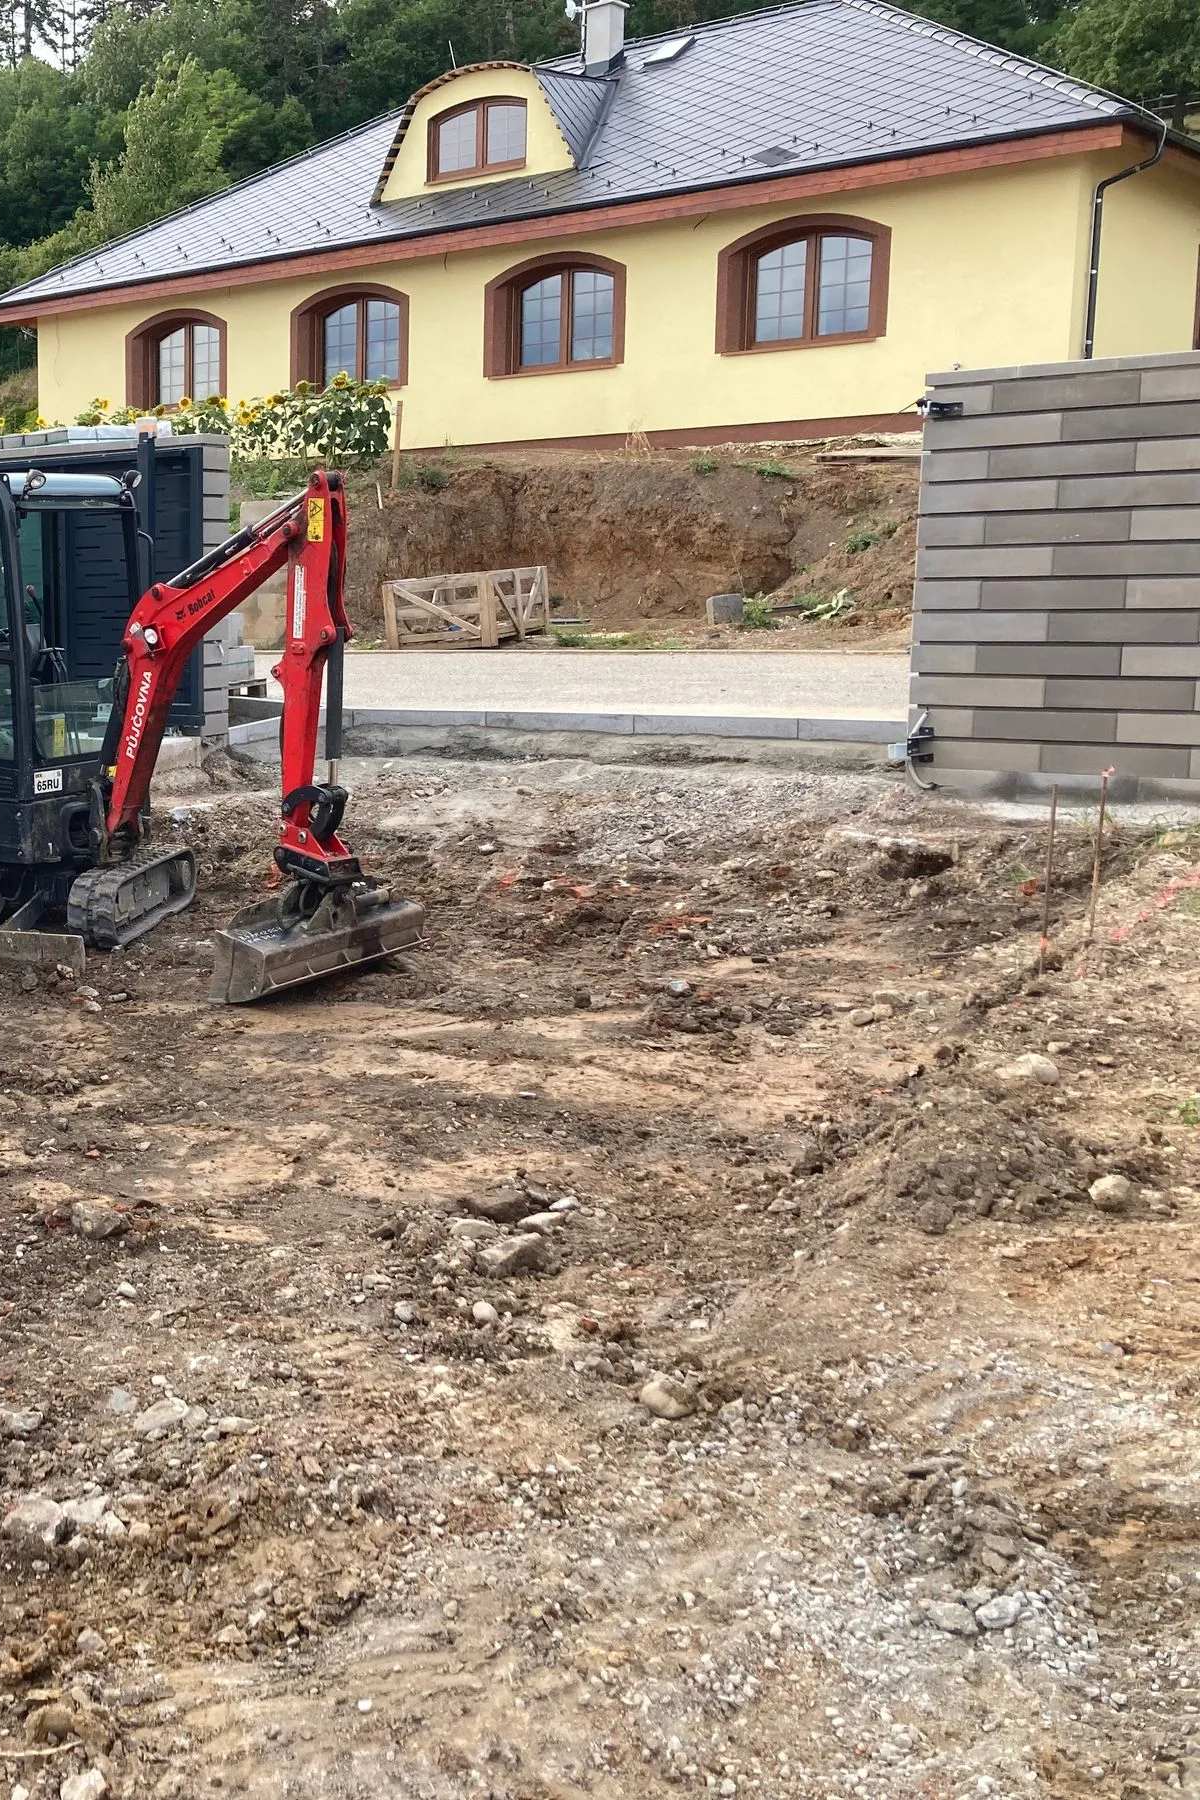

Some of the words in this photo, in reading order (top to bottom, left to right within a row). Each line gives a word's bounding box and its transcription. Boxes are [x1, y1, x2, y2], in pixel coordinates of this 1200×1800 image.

[187, 588, 216, 616] Bobcat
[125, 670, 153, 761] PŮJČOVNA
[36, 778, 59, 791] 65RU
